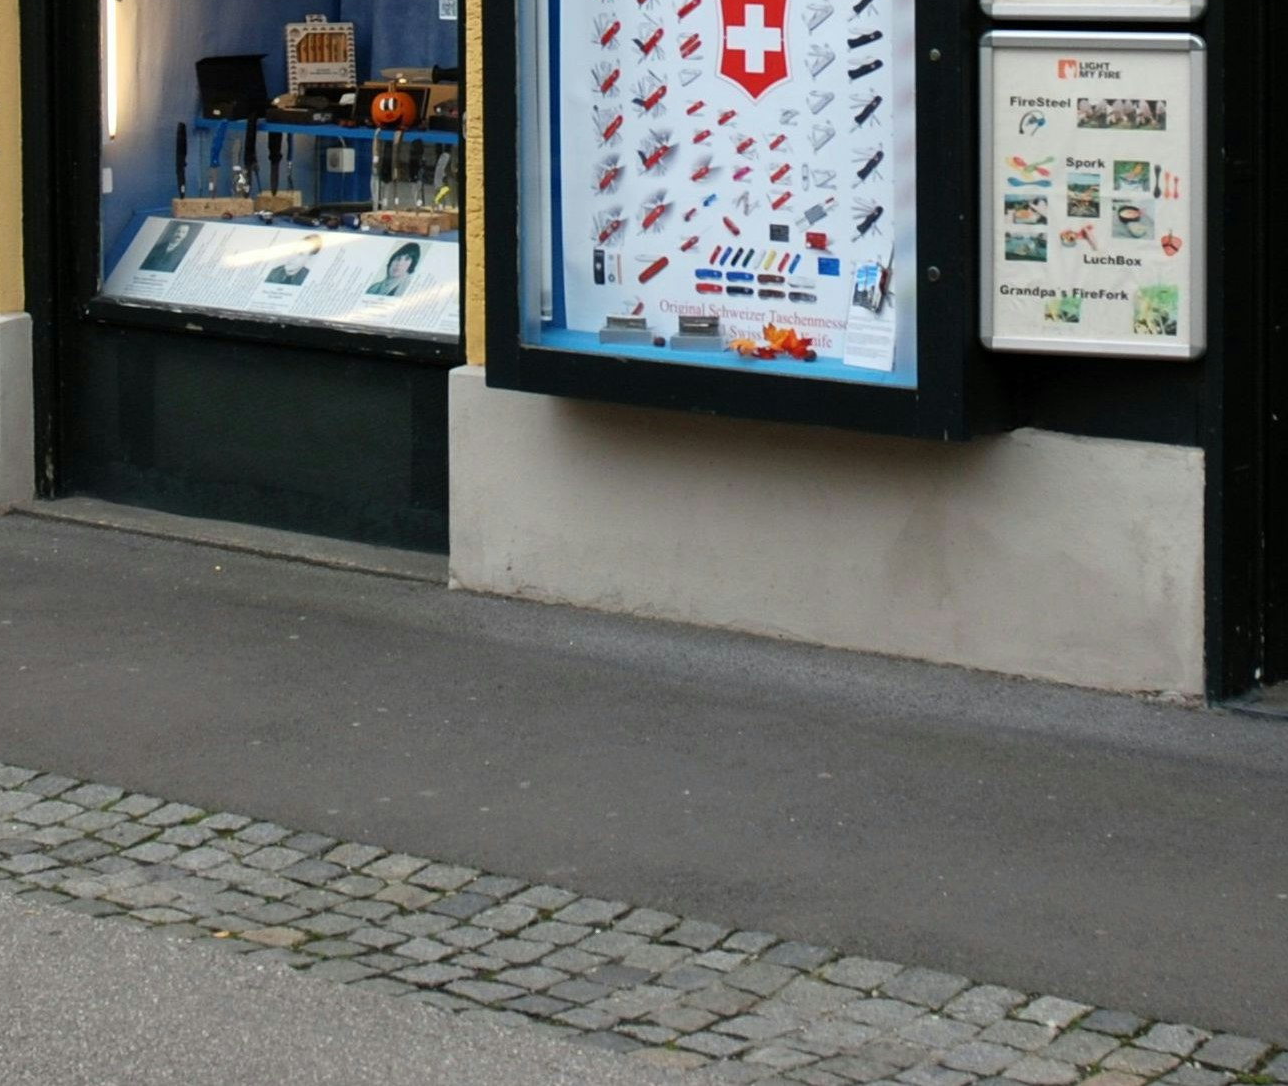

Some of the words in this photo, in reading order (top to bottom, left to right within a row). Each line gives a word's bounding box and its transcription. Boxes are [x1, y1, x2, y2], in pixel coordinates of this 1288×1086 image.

[1079, 62, 1110, 71] LIGHT
[1098, 71, 1121, 79] FIRE
[1010, 96, 1071, 109] FireSteel
[1066, 157, 1105, 169] Spork
[1083, 254, 1142, 266] LuchBox
[1072, 288, 1129, 301] FireFork
[660, 300, 706, 318] Original
[708, 304, 766, 321] Schweizer
[769, 310, 848, 330] Taschenmesse
